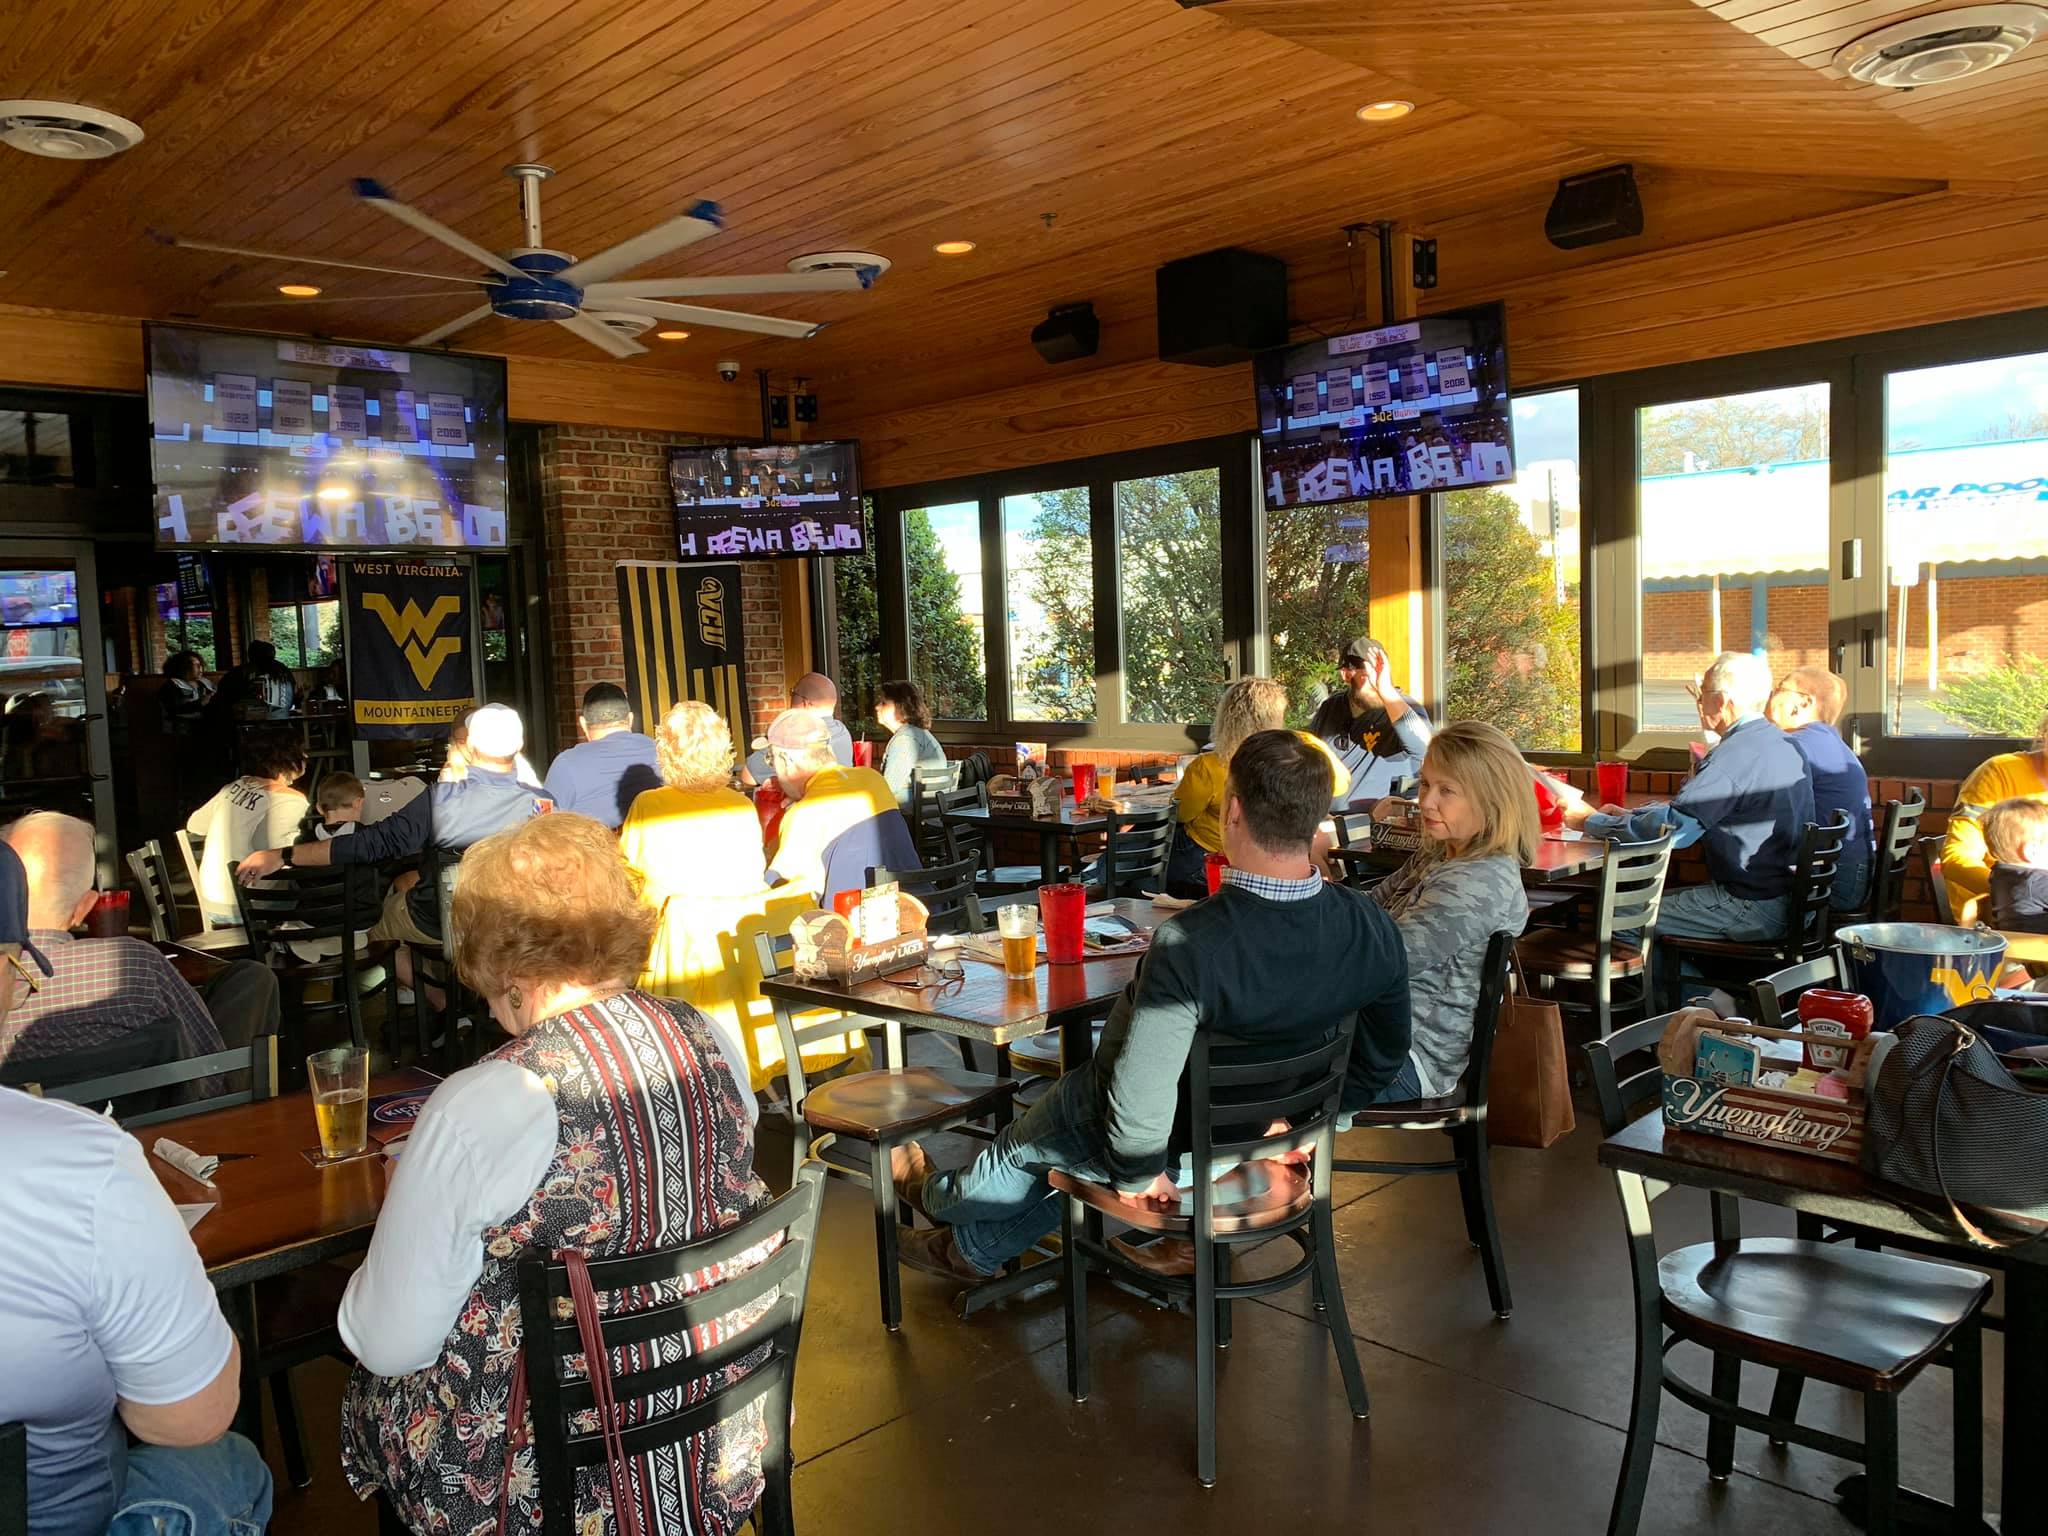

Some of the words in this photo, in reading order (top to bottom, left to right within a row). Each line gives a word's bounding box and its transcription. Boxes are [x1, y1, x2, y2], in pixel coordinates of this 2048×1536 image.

[1949, 477, 2048, 496] POO
[353, 563, 392, 576] WEST
[396, 565, 463, 577] VIRGINIA
[228, 783, 264, 812] PINK
[1815, 1024, 1837, 1034] HEINZ
[1665, 1078, 1852, 1151] Yuengling
